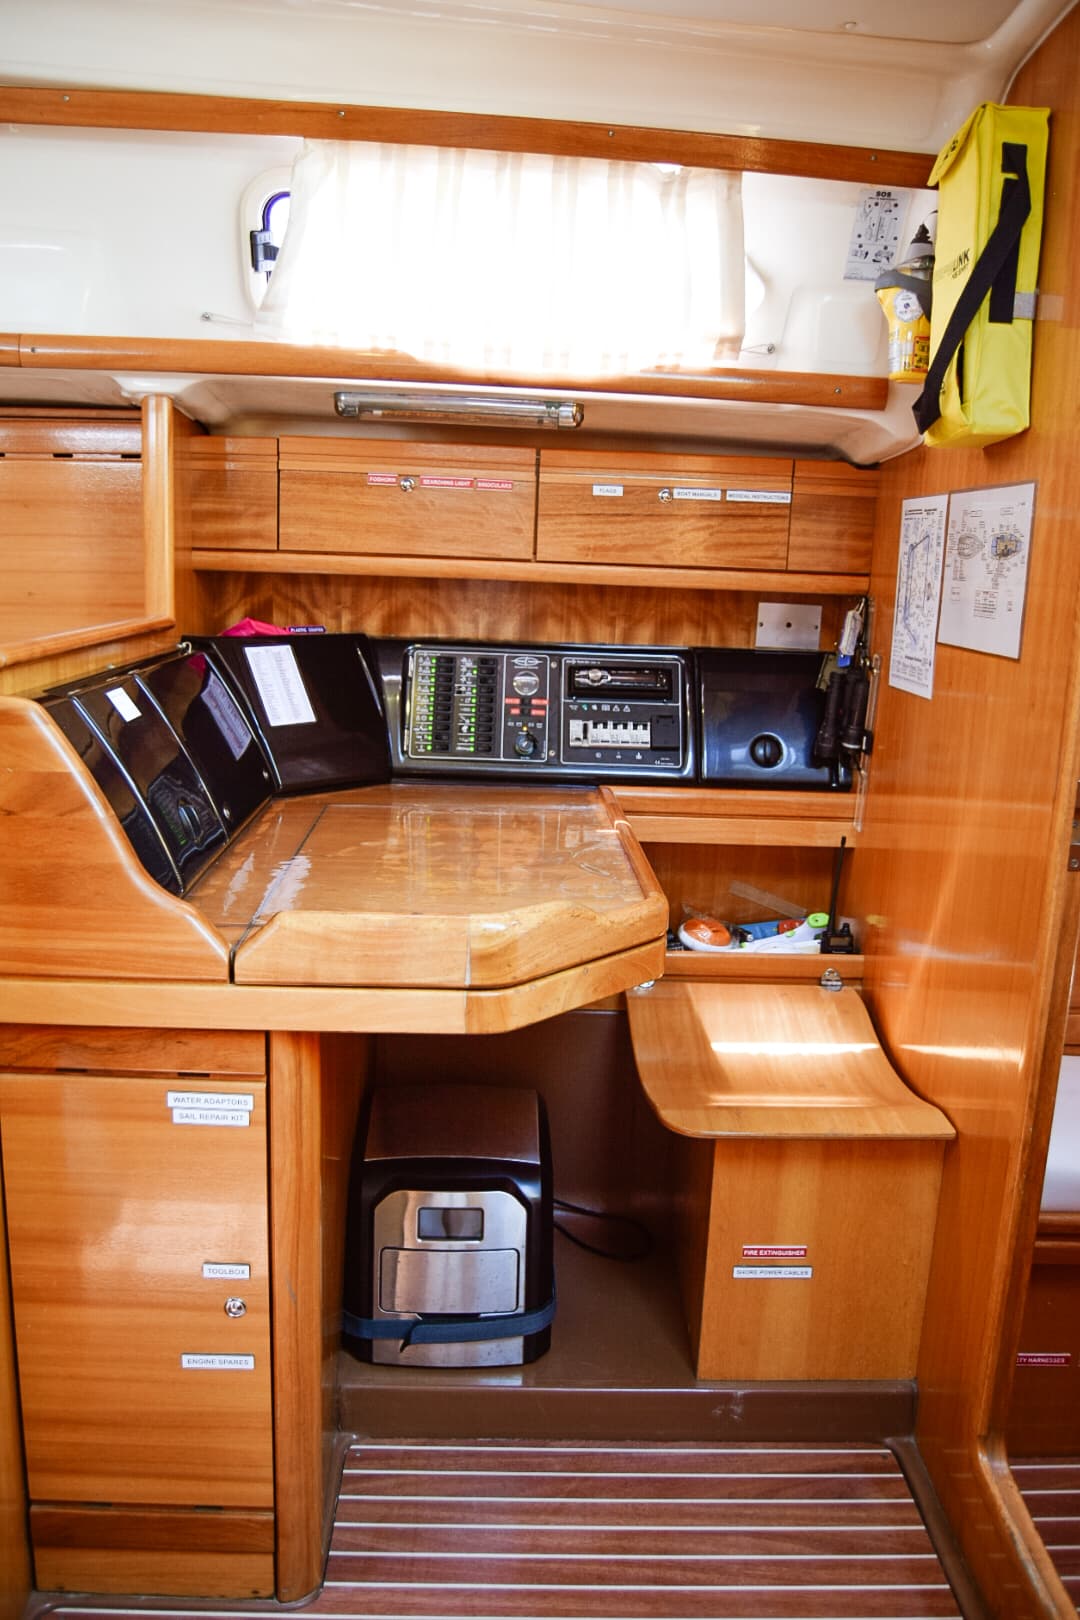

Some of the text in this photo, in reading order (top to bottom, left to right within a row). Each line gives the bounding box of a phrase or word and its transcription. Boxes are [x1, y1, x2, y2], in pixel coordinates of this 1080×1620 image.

[477, 481, 512, 489] BINOCULARS
[752, 493, 789, 501] INSTRUCTIONS
[173, 1096, 248, 1106] WATER ADAPTORS
[179, 1112, 197, 1120] SAIL
[199, 1113, 229, 1121] REPAIR
